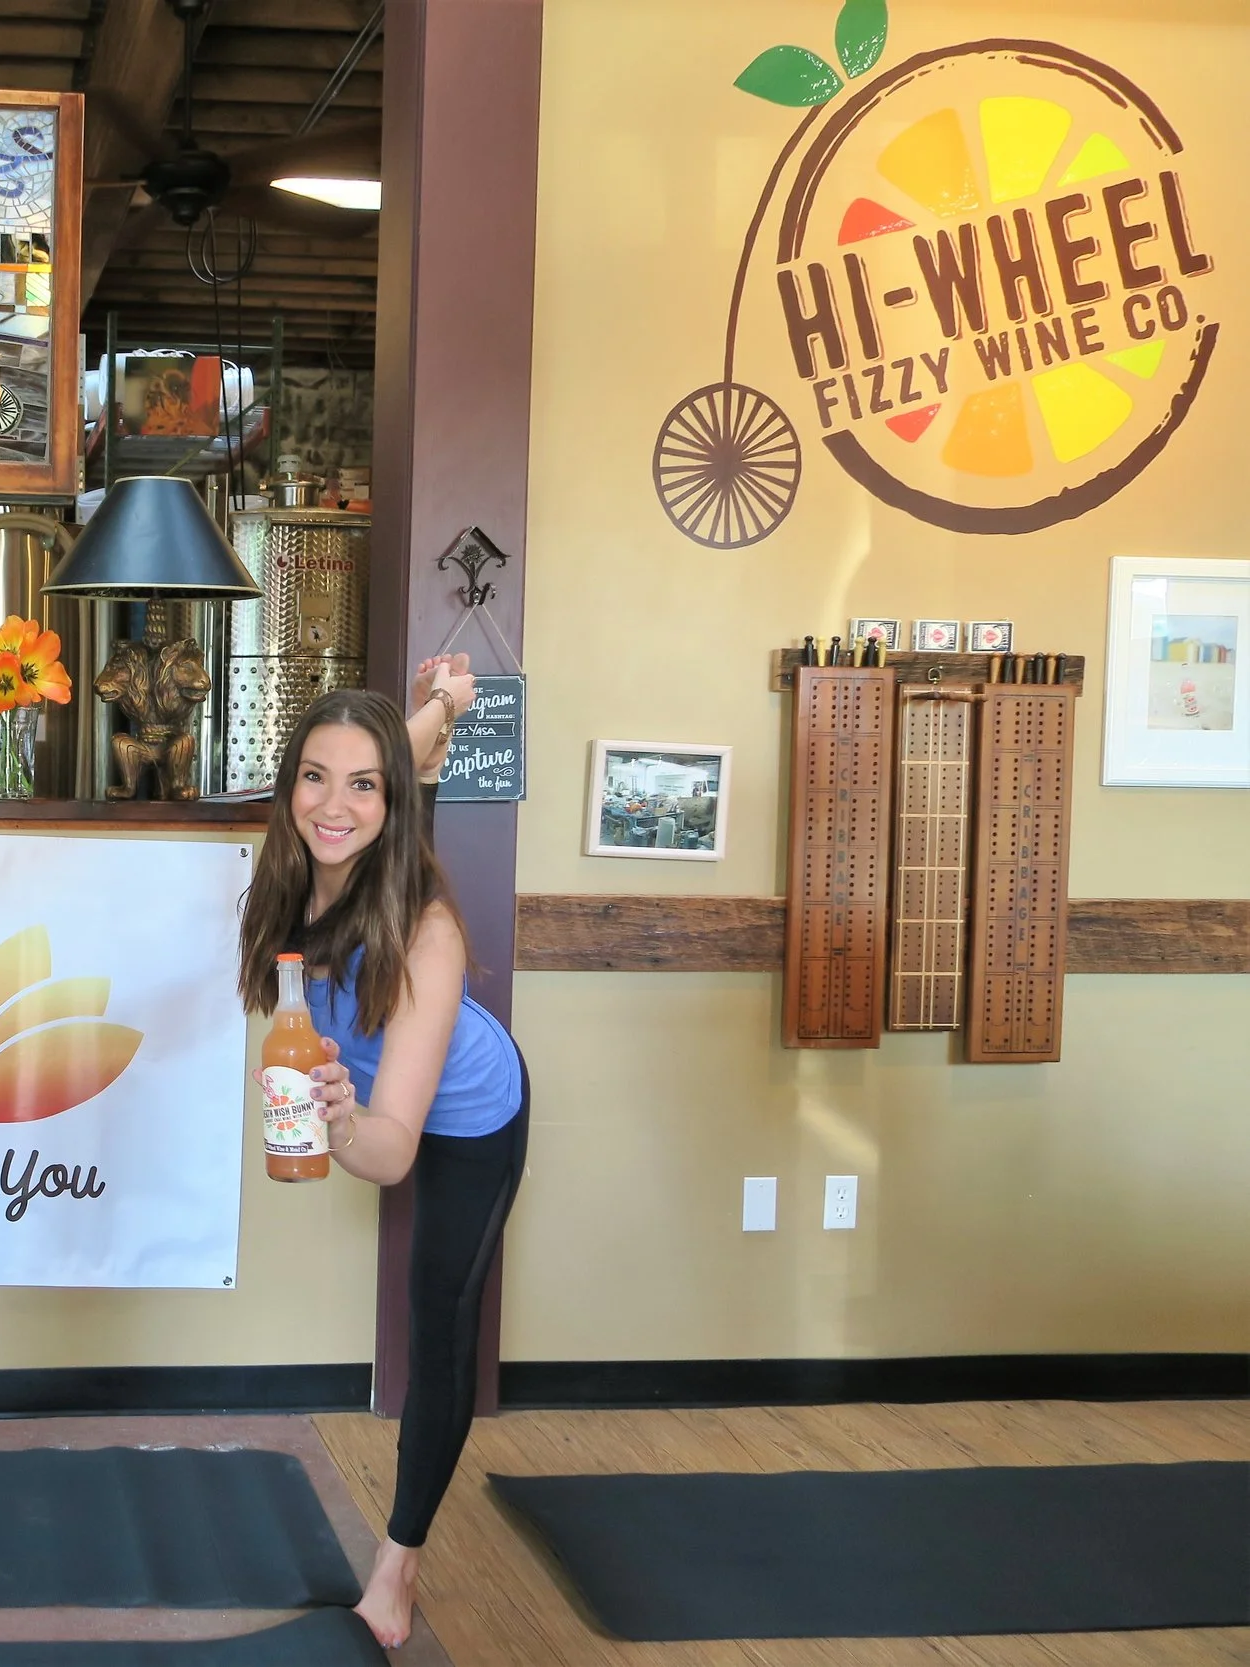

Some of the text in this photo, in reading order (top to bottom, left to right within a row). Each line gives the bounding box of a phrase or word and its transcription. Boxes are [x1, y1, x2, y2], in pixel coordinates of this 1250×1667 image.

[776, 170, 1214, 381] HI-WHEEL
[813, 284, 1207, 429] FIZZY WINE CO.
[294, 554, 354, 571] Letina
[946, 625, 956, 648] BICYCLE
[999, 626, 1010, 649] BICYCLE
[458, 744, 470, 752] us
[438, 747, 515, 784] Capture
[477, 775, 513, 792] the fun
[1017, 784, 1032, 942] CRIBBAGE
[274, 1107, 290, 1117] WISH
[291, 1101, 315, 1114] BUNNY
[0, 1148, 106, 1223] You
